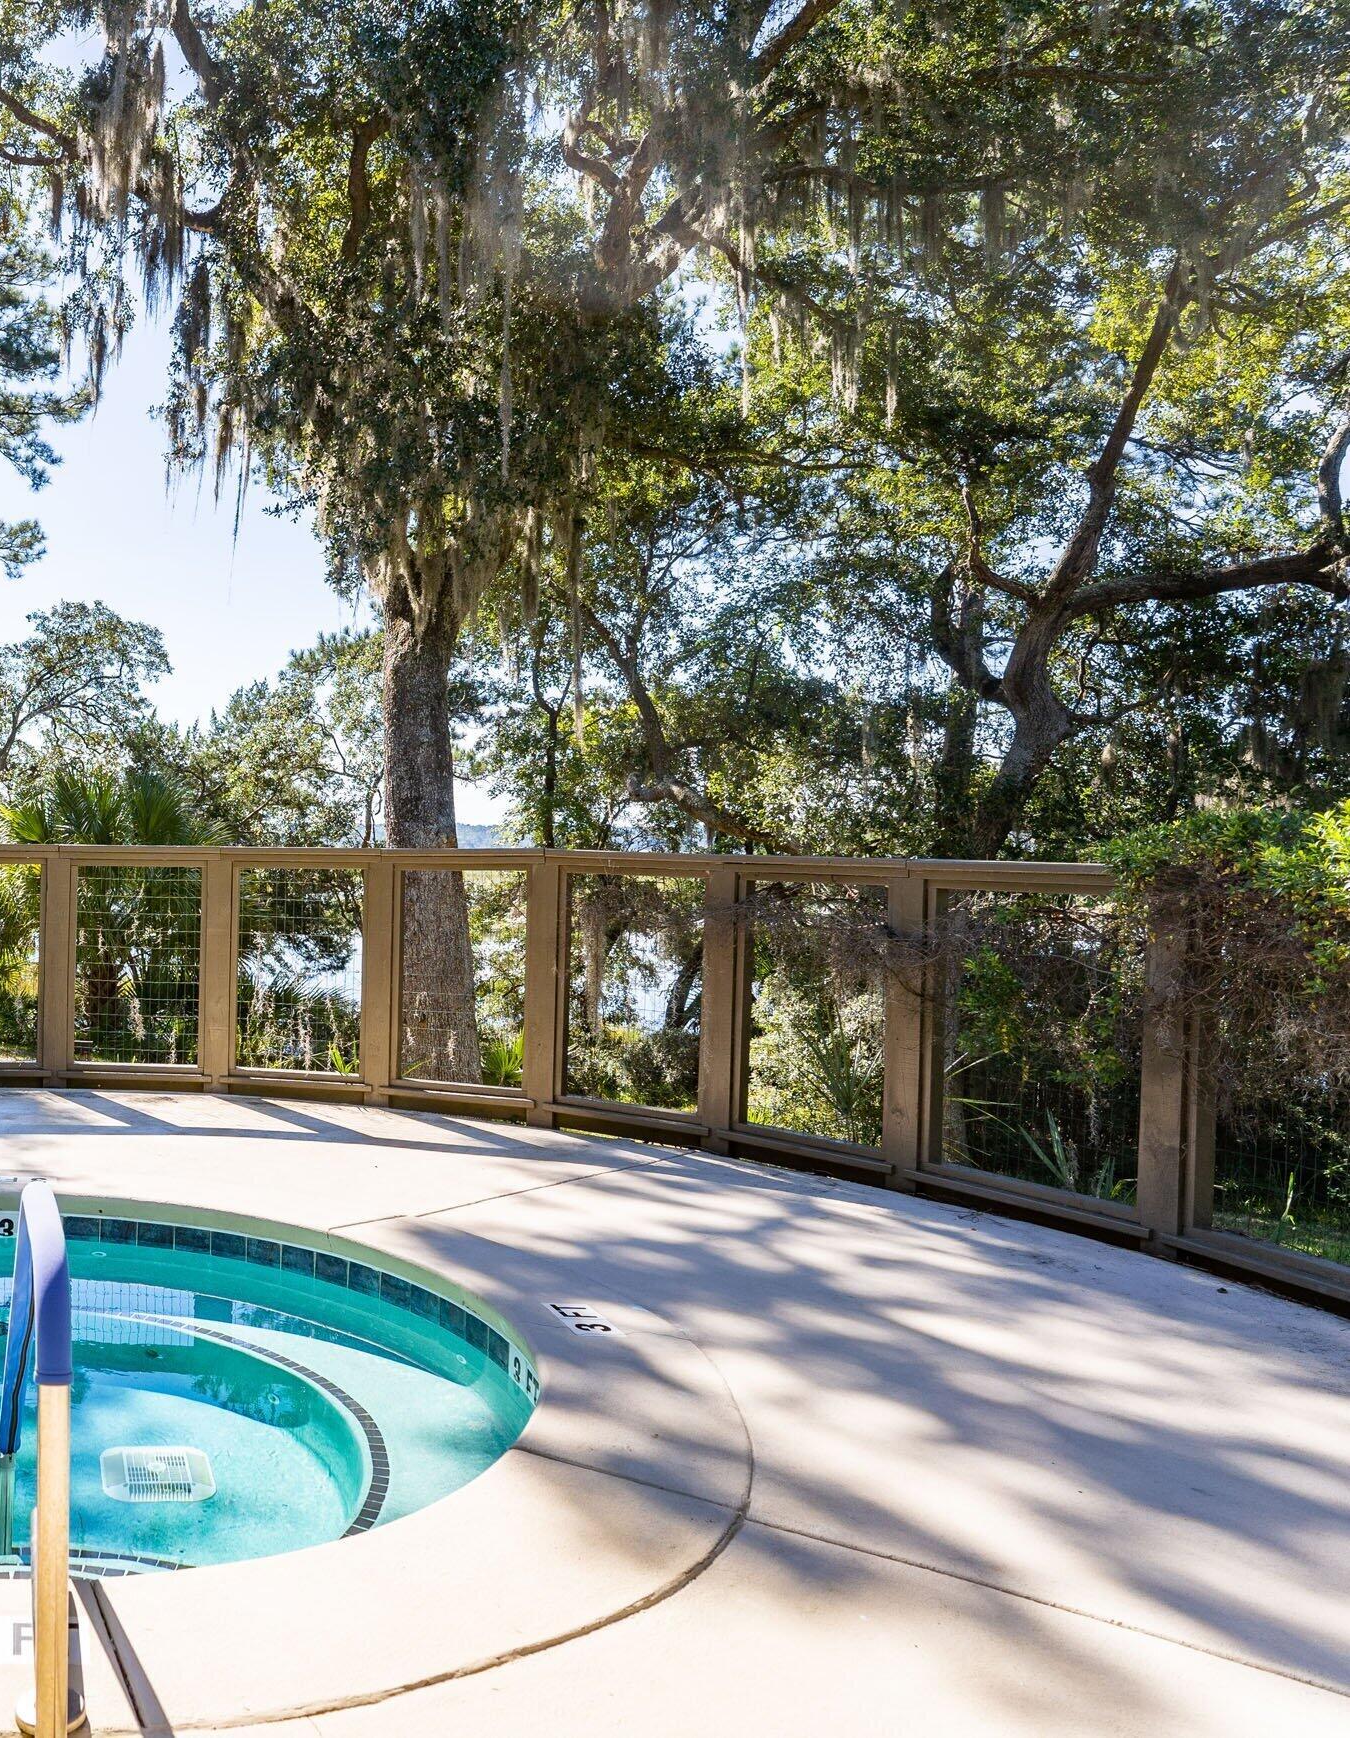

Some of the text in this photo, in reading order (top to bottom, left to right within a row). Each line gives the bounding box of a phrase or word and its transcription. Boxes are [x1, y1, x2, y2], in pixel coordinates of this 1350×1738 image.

[0, 1218, 14, 1237] 3
[550, 1304, 612, 1332] 3 FT
[513, 1356, 539, 1402] 3 FT
